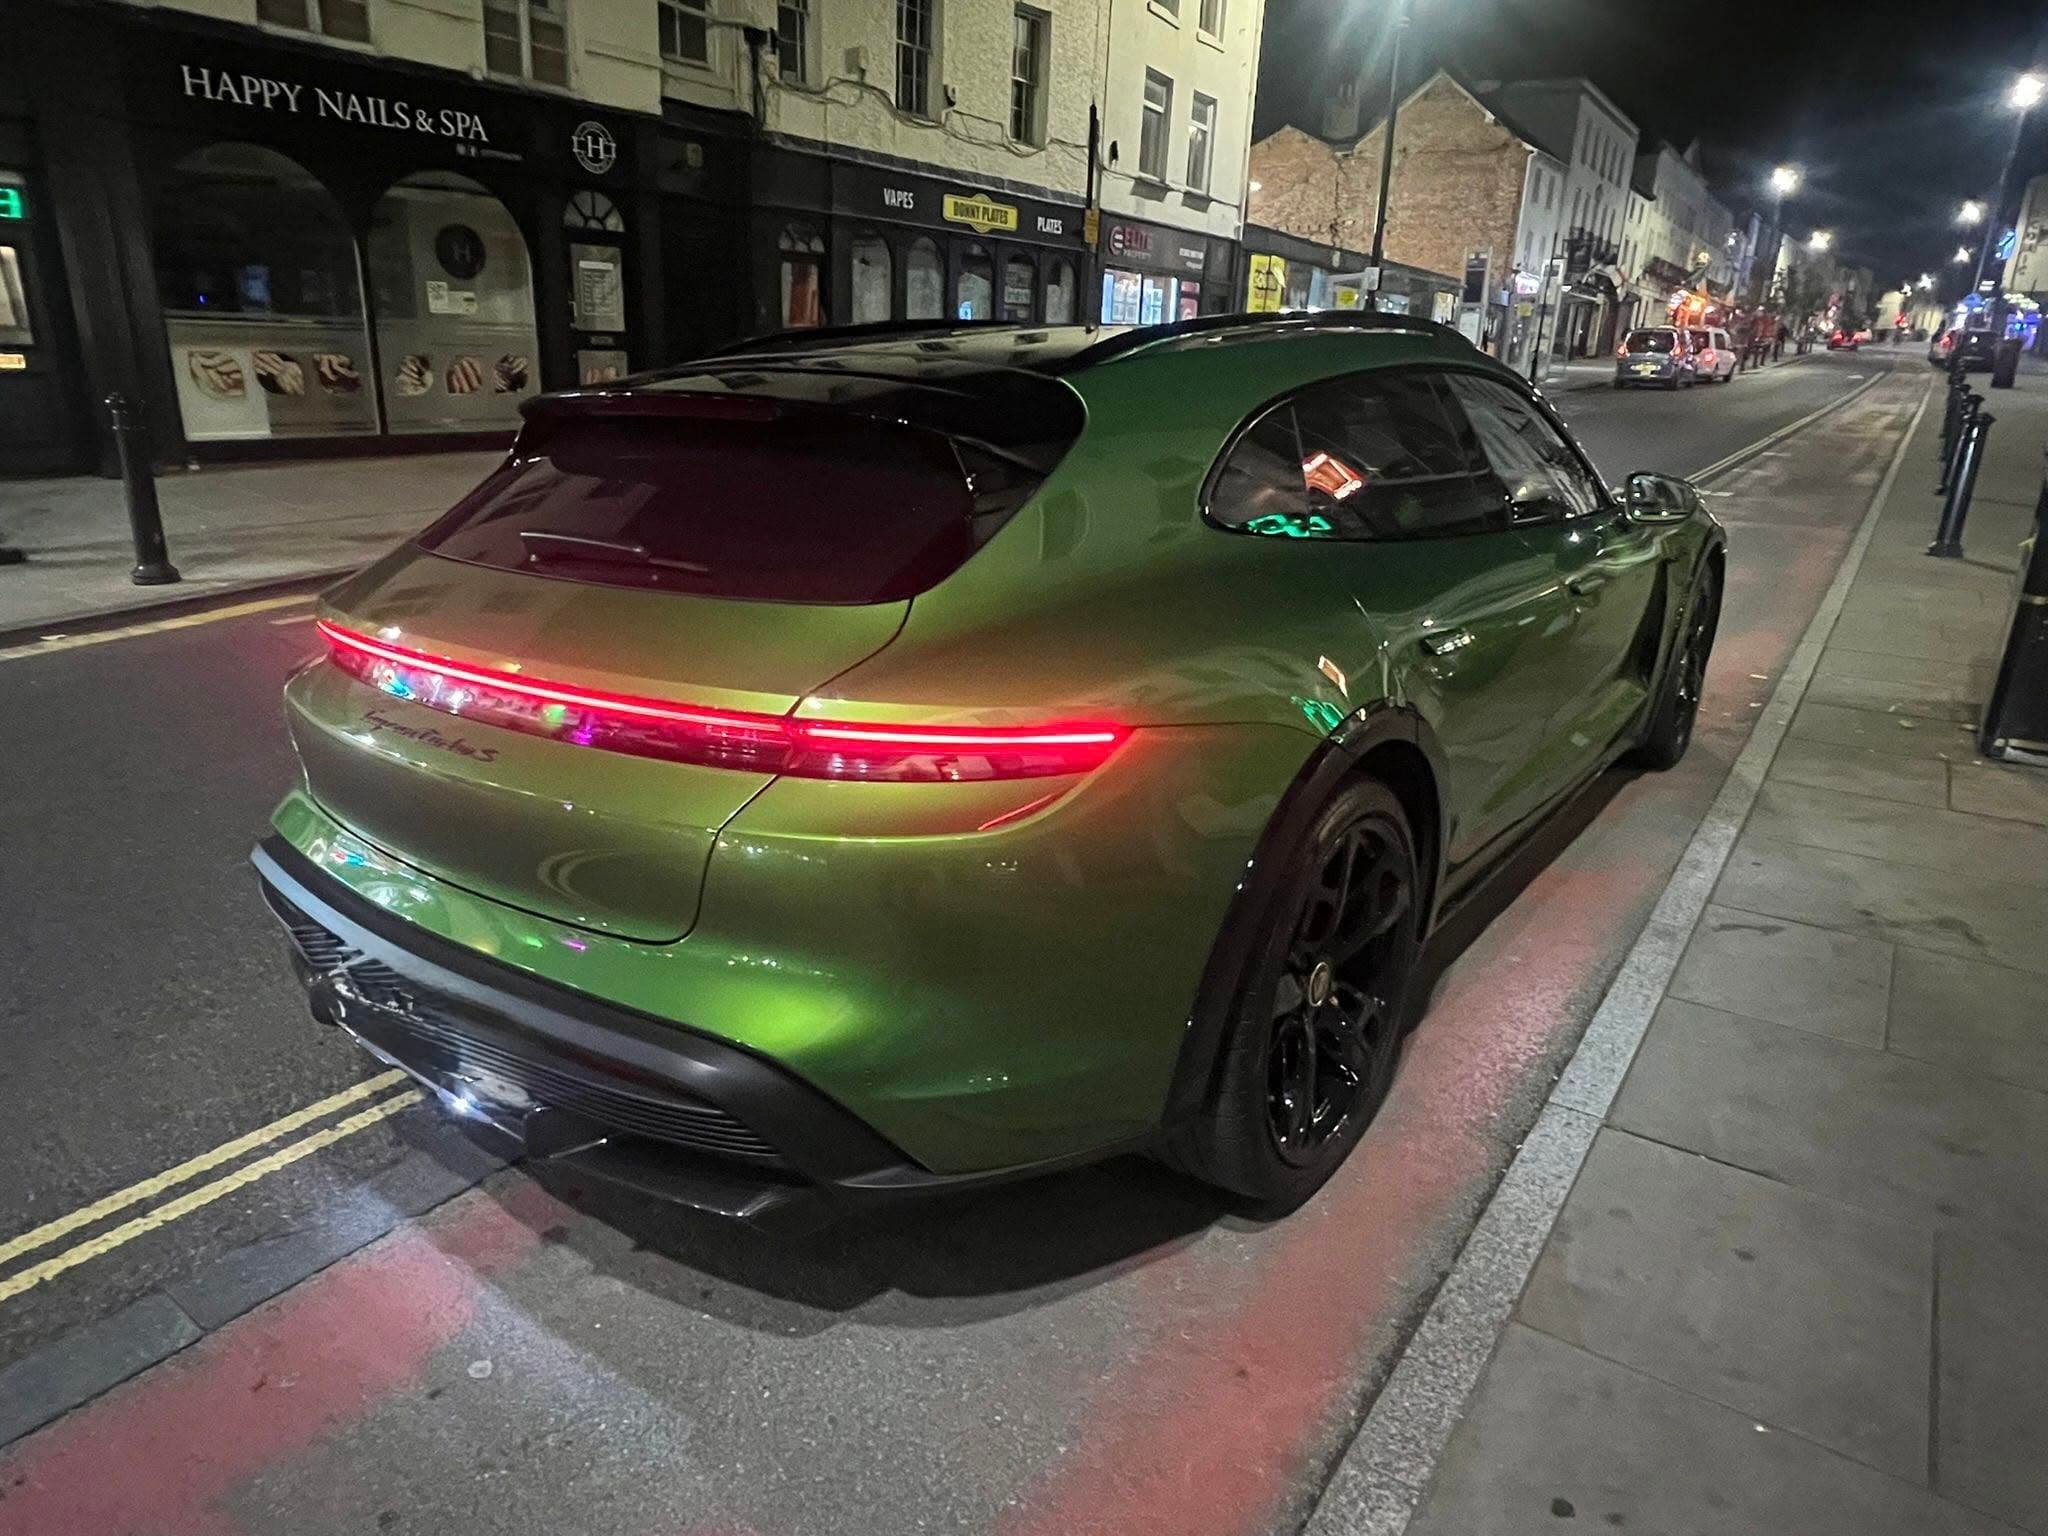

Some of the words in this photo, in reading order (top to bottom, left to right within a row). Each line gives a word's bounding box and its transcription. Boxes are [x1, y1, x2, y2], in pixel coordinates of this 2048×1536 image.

[180, 65, 302, 113] HAPPY
[314, 88, 411, 130] NAILS
[415, 109, 436, 134] &
[439, 110, 490, 143] SPA
[884, 188, 914, 209] VAPES
[981, 206, 1008, 225] PLATES
[1037, 216, 1063, 235] PLATES
